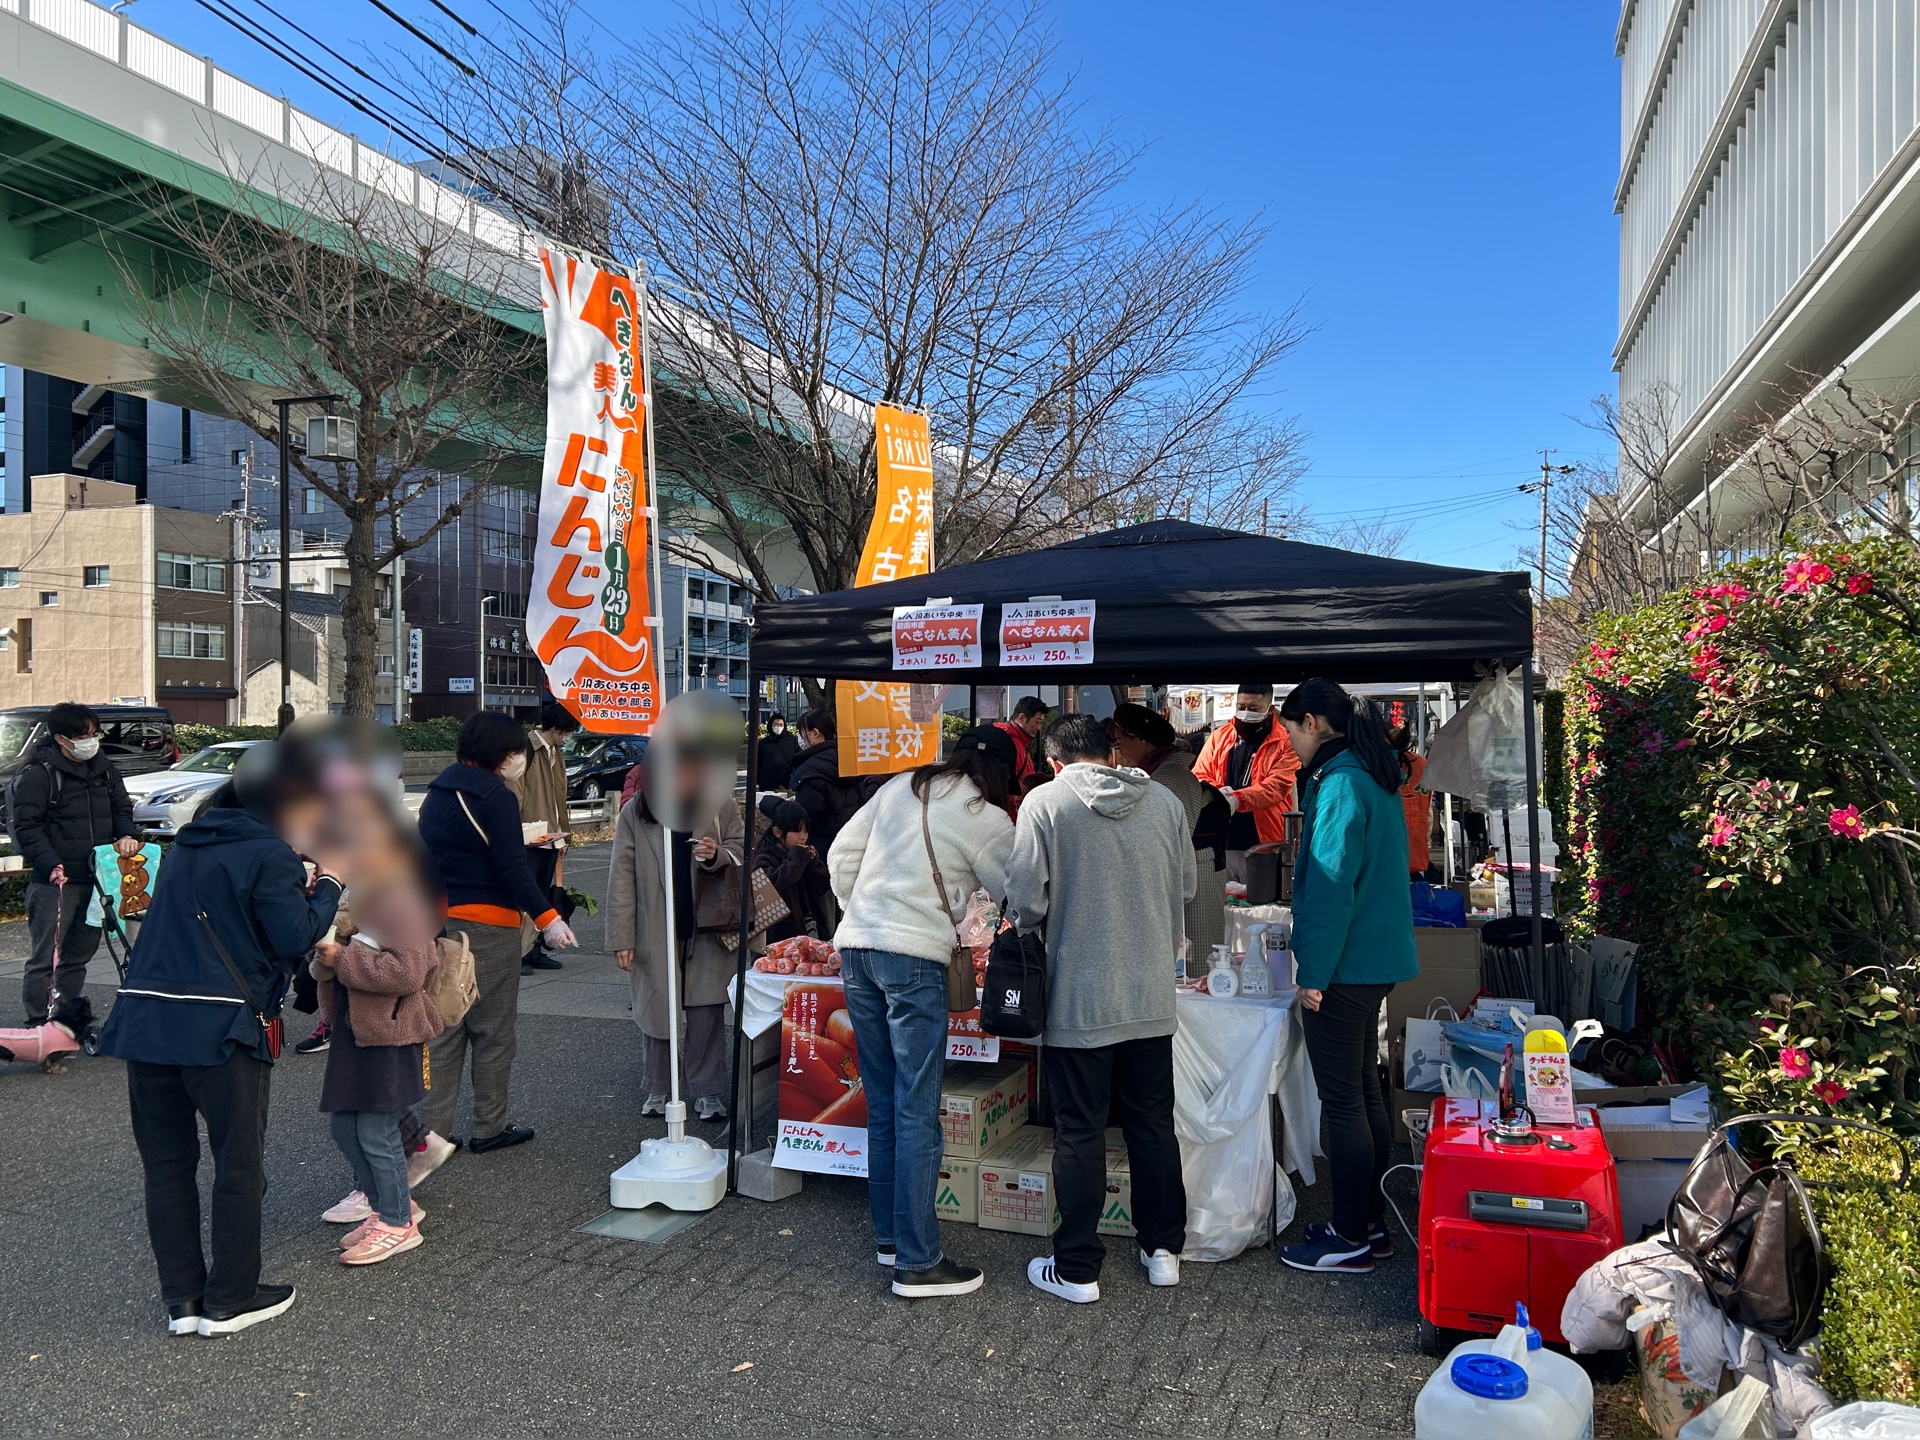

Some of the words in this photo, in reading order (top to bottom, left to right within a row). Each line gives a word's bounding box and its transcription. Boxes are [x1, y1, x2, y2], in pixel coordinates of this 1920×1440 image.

[611, 288, 636, 410] へきなん
[594, 362, 637, 433] 美人
[537, 432, 647, 673] にんじん
[603, 545, 627, 632] 1月23日
[914, 611, 963, 620] JAあいち中央
[1025, 608, 1075, 617] JAあいち中央
[900, 627, 972, 642] へきなん美人
[1008, 624, 1084, 638] へきなん美人
[899, 658, 927, 666] 3本入り
[1007, 654, 1035, 662] 3本入り
[581, 678, 651, 693] JAあいち中央
[580, 693, 652, 707] 碧南人参部会
[1005, 989, 1021, 1005] SN
[984, 1090, 1027, 1126] へきなん美人
[783, 1125, 824, 1138] にんじん
[781, 1136, 862, 1156] へきなん美人
